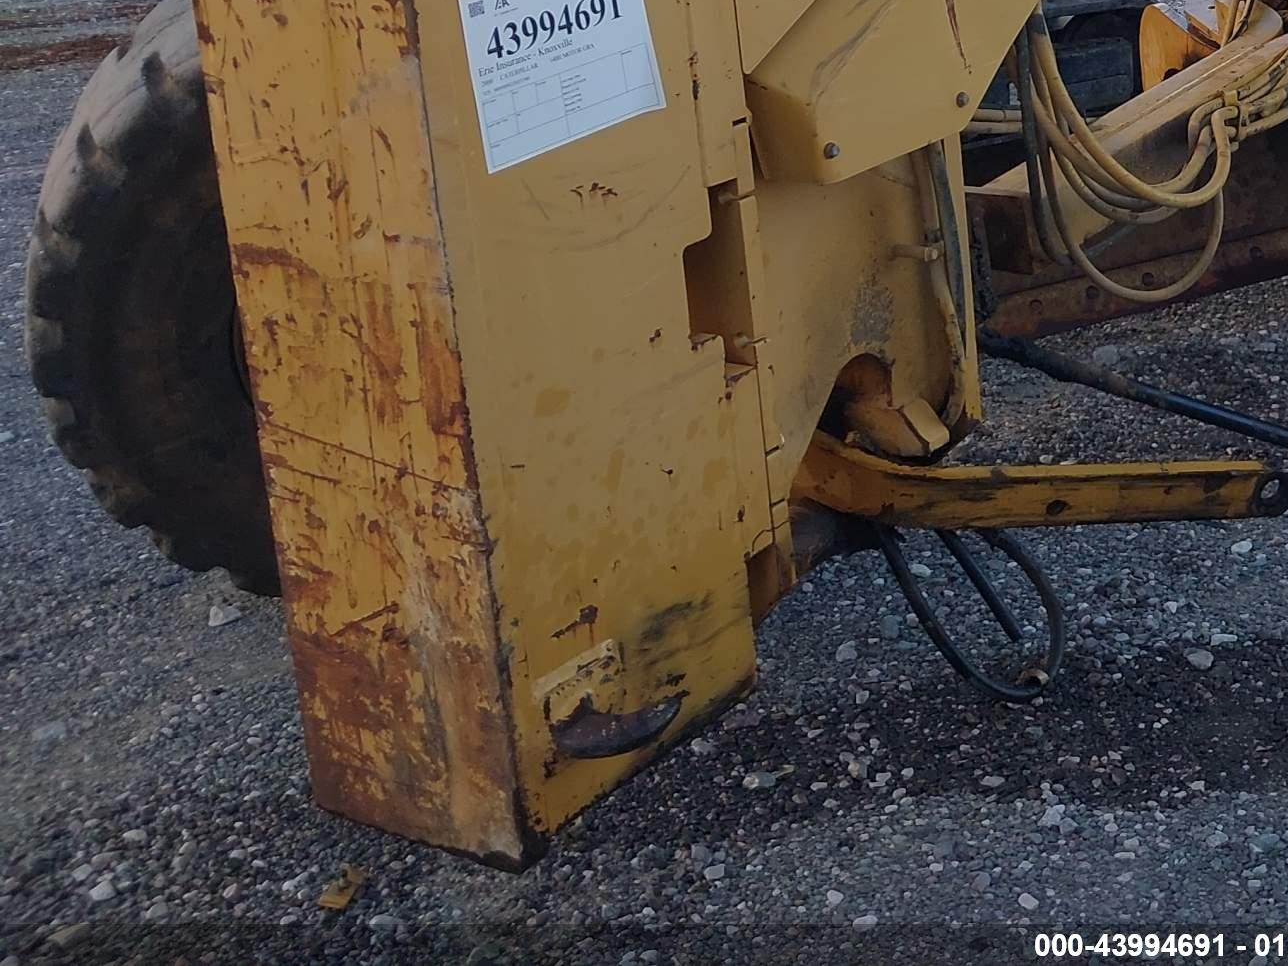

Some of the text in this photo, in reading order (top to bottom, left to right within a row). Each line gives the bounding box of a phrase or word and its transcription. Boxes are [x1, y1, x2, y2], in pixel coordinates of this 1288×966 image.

[478, 66, 494, 77] Erie
[496, 53, 532, 71] Insurance
[537, 38, 573, 56] Knoxville
